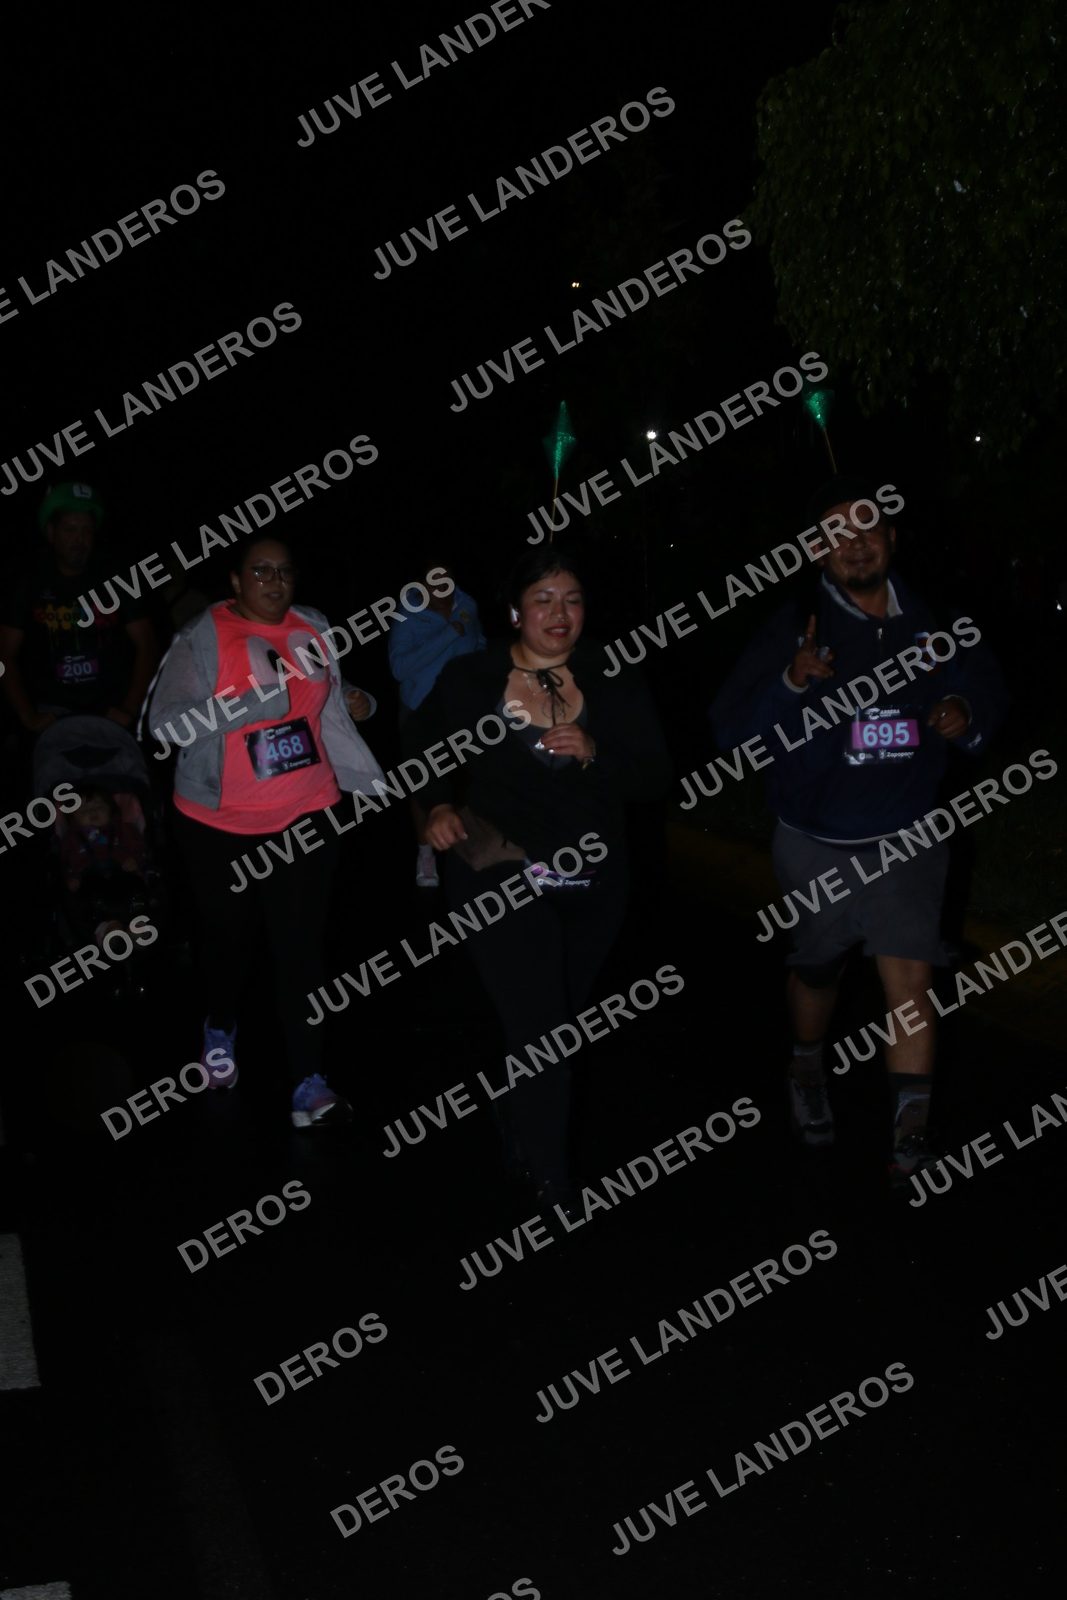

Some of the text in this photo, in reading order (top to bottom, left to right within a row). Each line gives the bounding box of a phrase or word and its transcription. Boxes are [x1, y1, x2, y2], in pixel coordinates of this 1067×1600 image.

[63, 661, 92, 677] 200
[862, 722, 910, 747] 695
[266, 735, 304, 762] 468
